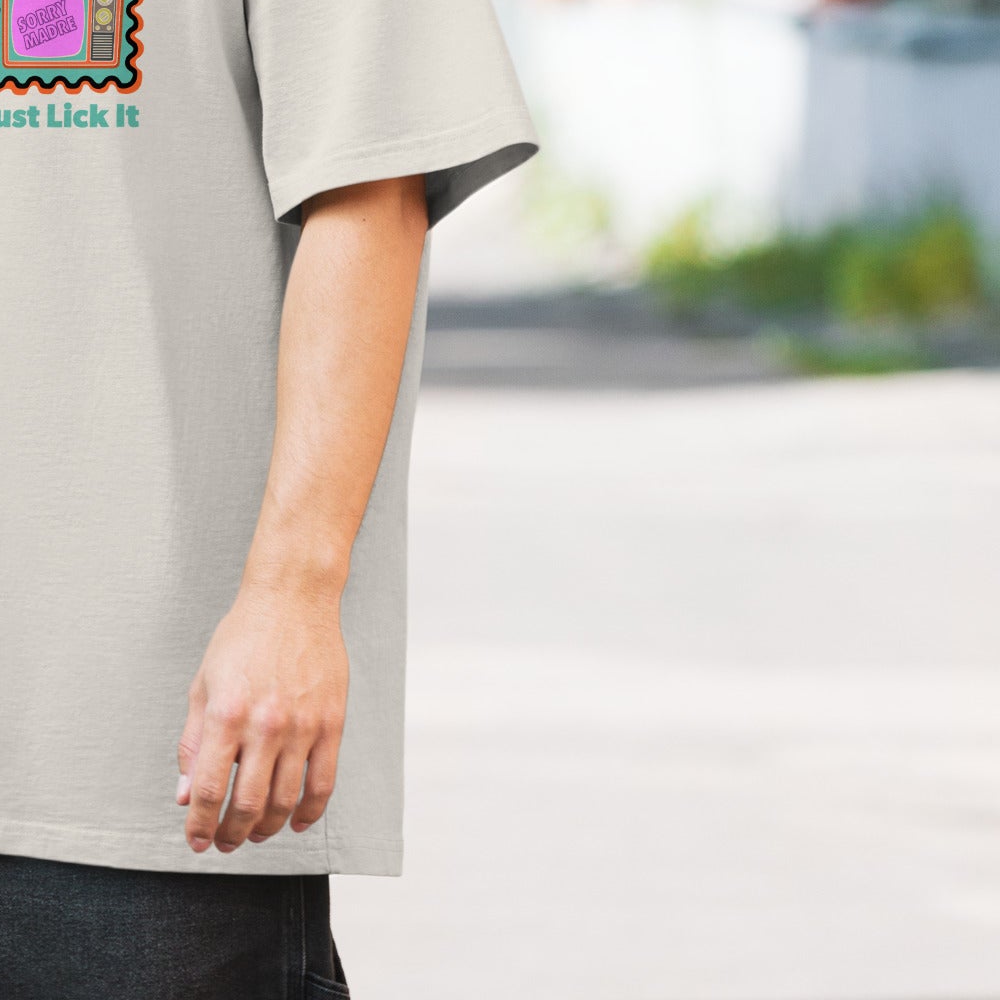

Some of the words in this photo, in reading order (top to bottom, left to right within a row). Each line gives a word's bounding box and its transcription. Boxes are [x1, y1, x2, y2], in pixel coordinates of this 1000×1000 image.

[17, 0, 67, 34] SORRY
[23, 16, 78, 50] MADRE
[46, 102, 110, 128] Lick
[116, 103, 140, 128] It
